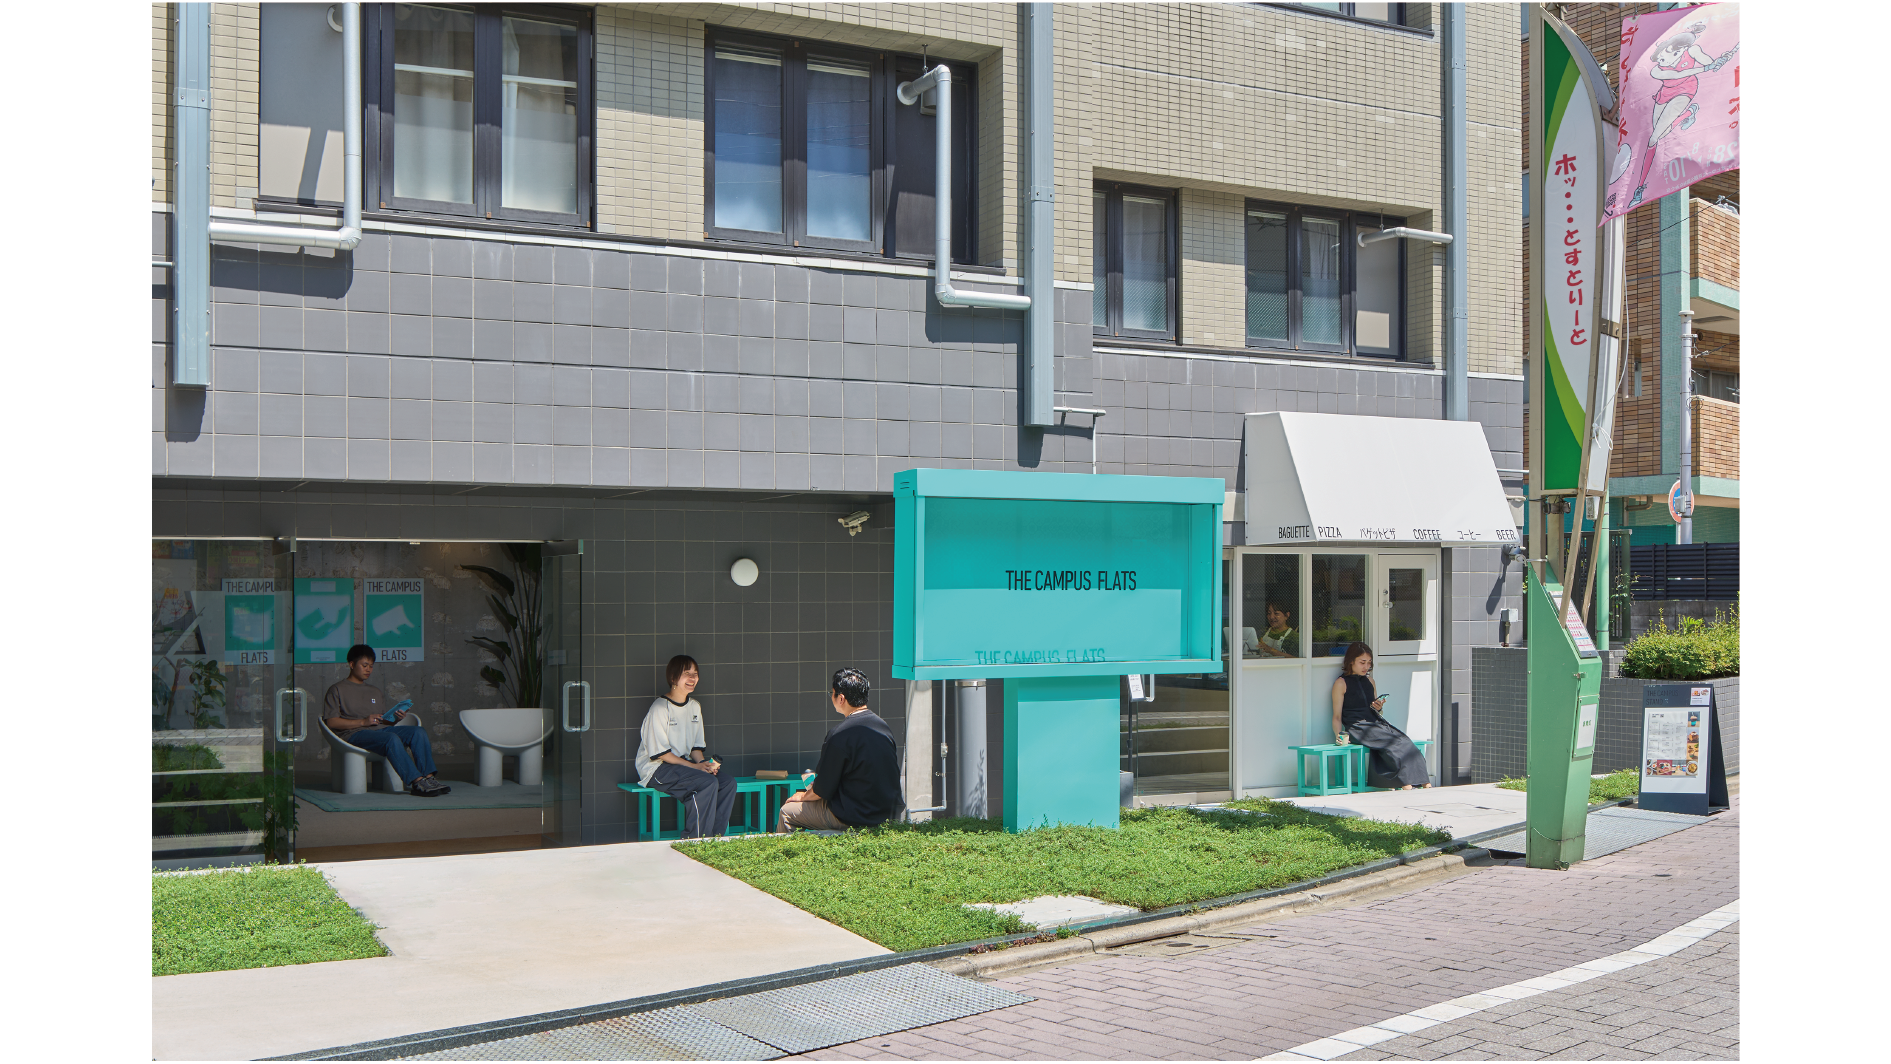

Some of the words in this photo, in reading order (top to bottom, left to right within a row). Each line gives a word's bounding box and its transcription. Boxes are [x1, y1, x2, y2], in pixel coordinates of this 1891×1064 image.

[1278, 525, 1310, 539] BAGUETTE
[1318, 526, 1342, 538] PIZZA
[1412, 528, 1442, 540] COFFEE
[1457, 530, 1481, 540] コーヒー
[1495, 528, 1516, 540] BEER
[367, 581, 384, 592] THE
[385, 581, 421, 592] CAMPUS
[1005, 570, 1032, 591] THE
[1035, 570, 1092, 591] CAMPUS
[1098, 570, 1137, 591] FLATS
[226, 581, 244, 593] THE
[241, 652, 268, 664] FLATS
[381, 650, 407, 661] FLATS
